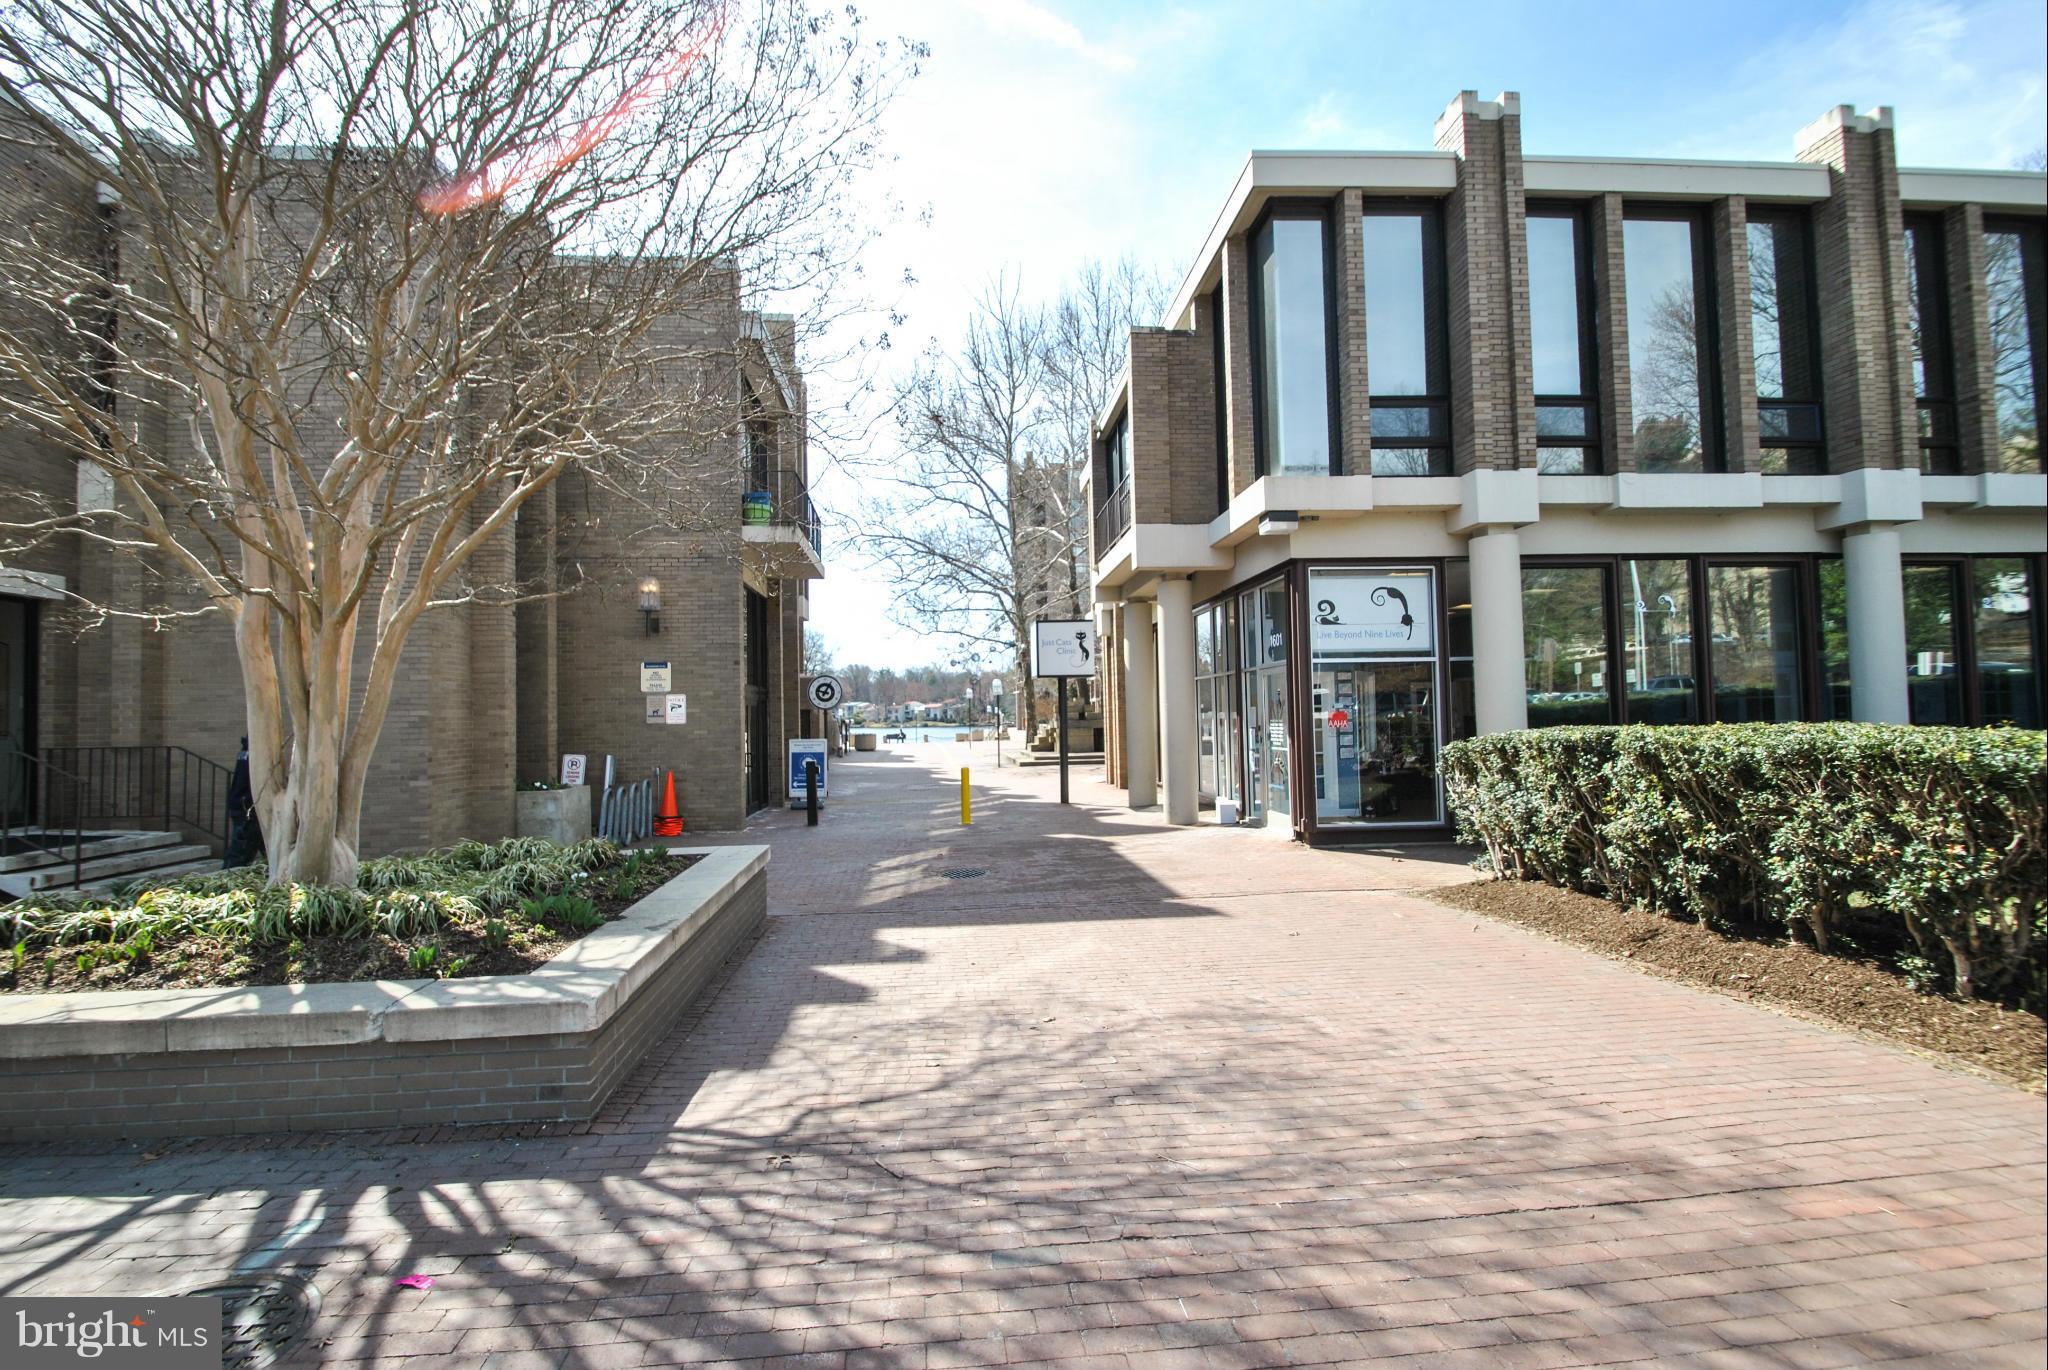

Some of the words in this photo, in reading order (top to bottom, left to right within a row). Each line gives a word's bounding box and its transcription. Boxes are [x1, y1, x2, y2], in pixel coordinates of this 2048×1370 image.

[1270, 633, 1283, 648] 1601
[1316, 631, 1332, 639] Live
[1335, 630, 1362, 641] Beyond
[1364, 630, 1383, 639] Nine
[1385, 630, 1404, 639] Lives
[1041, 639, 1055, 648] Just
[1055, 638, 1072, 646] Cats
[1056, 647, 1076, 655] Clinic
[1328, 719, 1348, 728] AAHA
